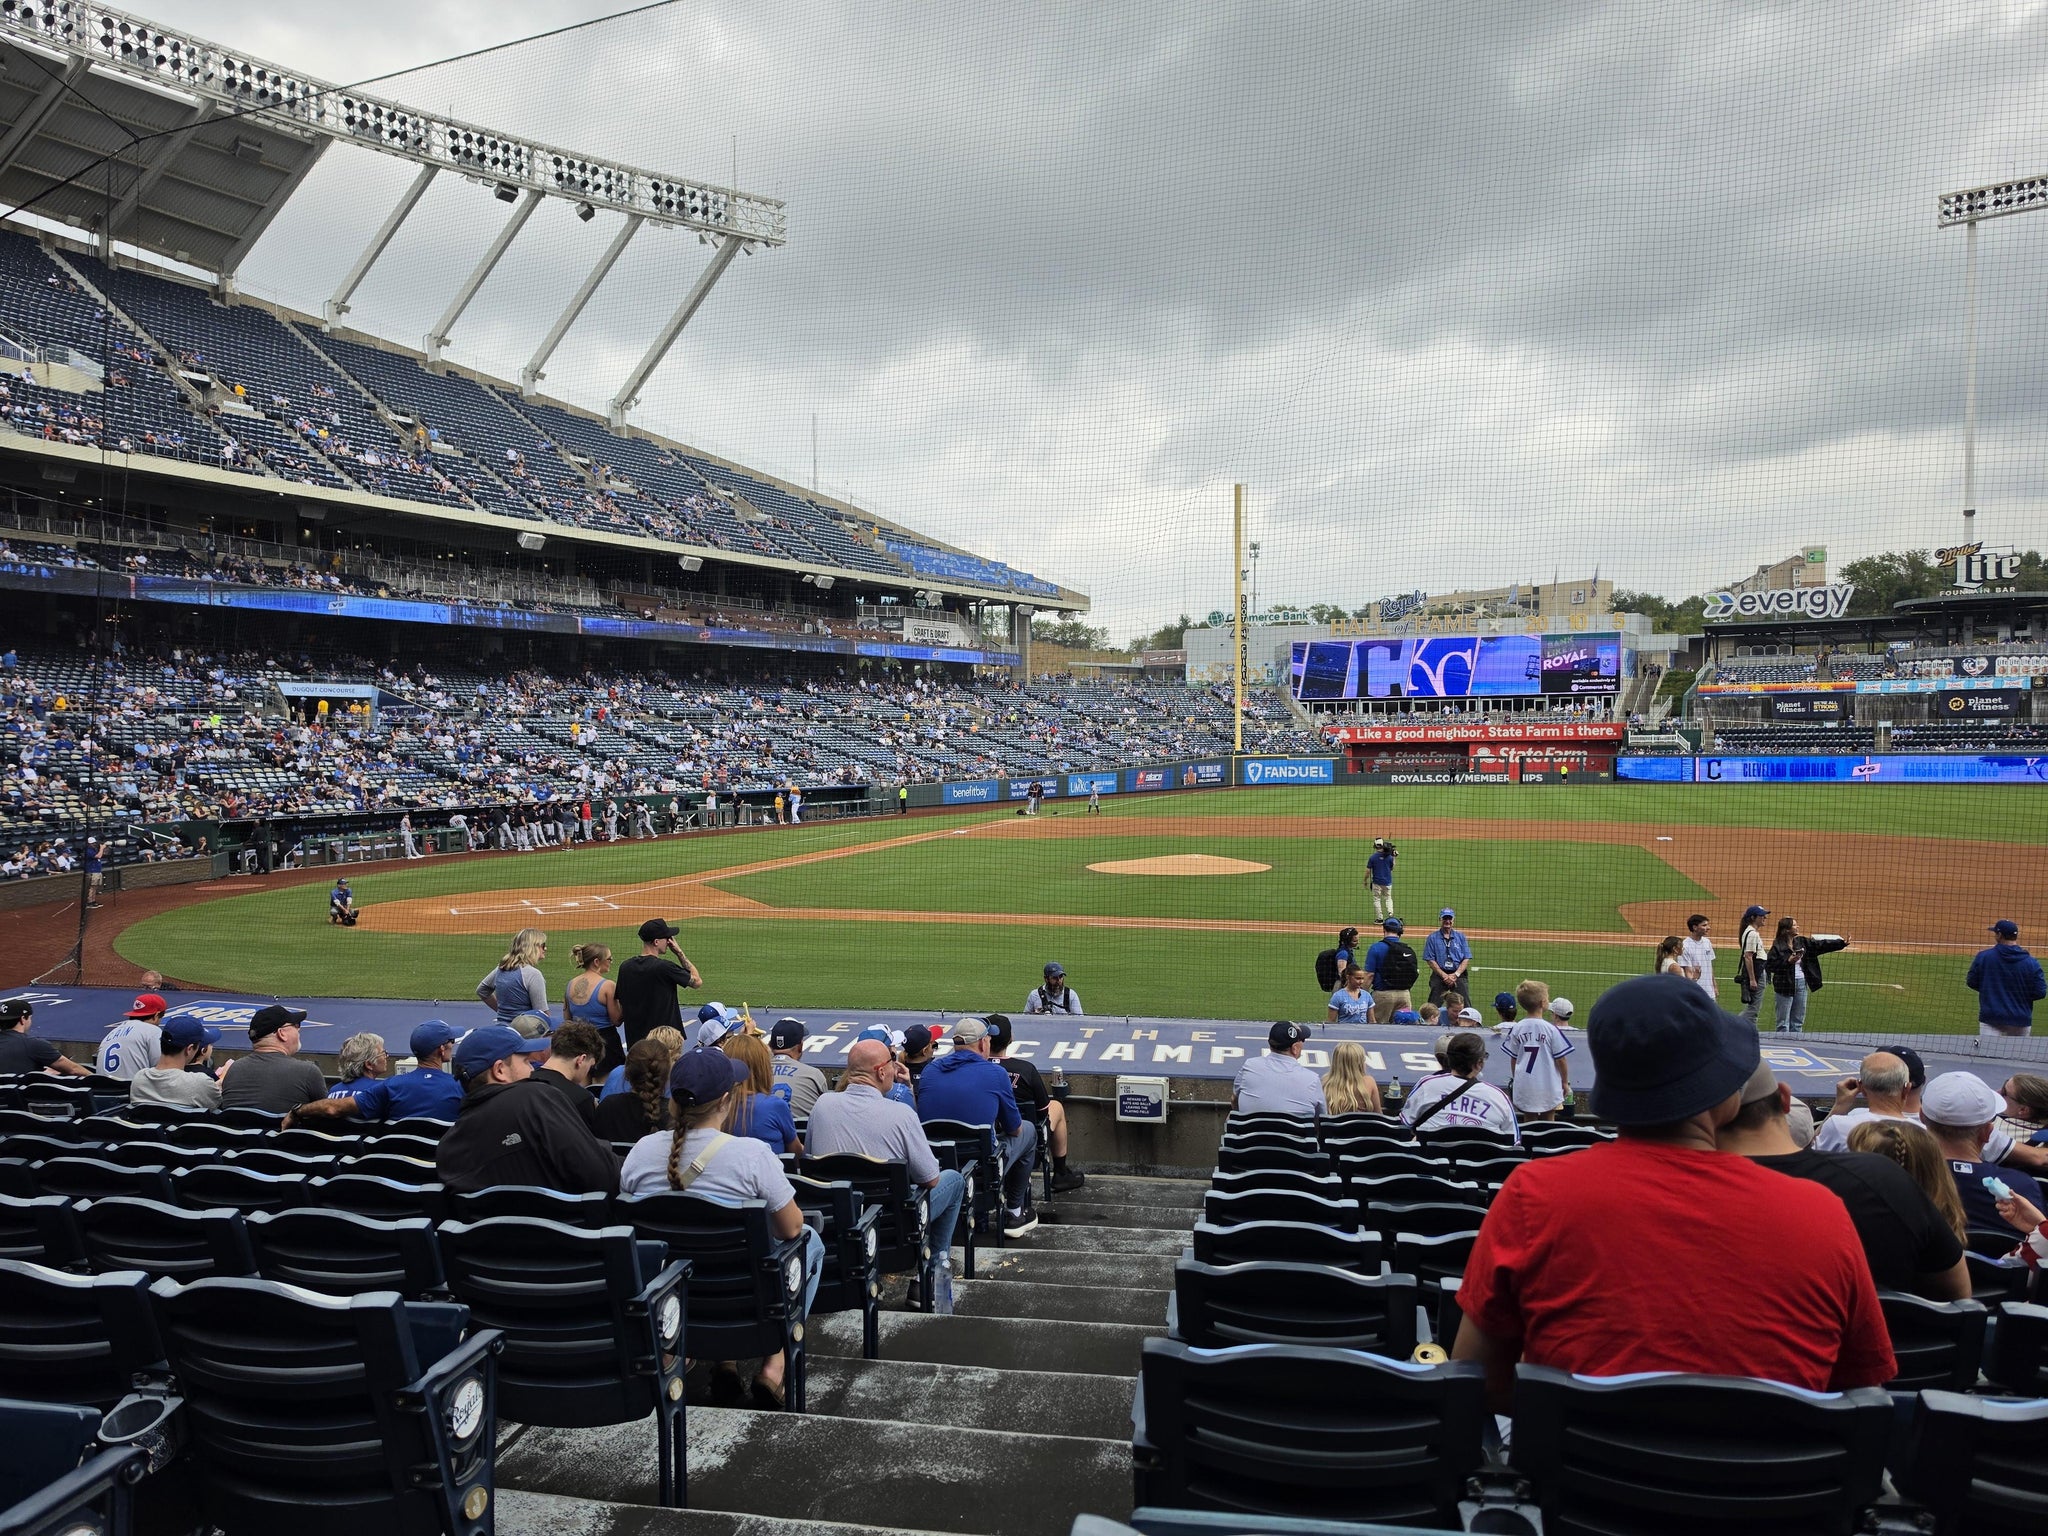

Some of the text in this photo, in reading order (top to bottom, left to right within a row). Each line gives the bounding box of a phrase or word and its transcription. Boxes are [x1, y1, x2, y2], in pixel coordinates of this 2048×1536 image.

[1935, 543, 1982, 563] Miller
[1953, 554, 2021, 588] Lite
[1939, 587, 1990, 597] FOUNTAIN
[1378, 589, 1428, 619] Royals
[1739, 588, 1850, 615] evergy
[1227, 610, 1309, 622] Cmerce Bank
[1330, 618, 1389, 636] HALL
[1414, 612, 1480, 634] FAME
[1525, 615, 1548, 632] 20
[1569, 613, 1588, 631] 10
[1612, 611, 1625, 630] 5
[914, 627, 930, 638] CRAFT
[934, 629, 950, 641] DRAFT
[1543, 648, 1588, 670] ROYAL
[1776, 701, 1801, 710] planet
[1968, 696, 2002, 706] planet
[1972, 703, 2010, 711] fitness
[1357, 725, 1618, 741] Like a good neighbor, State Farm is there.
[1264, 766, 1328, 779] FANDUEL
[1707, 759, 1722, 780] C
[1743, 762, 1787, 778] CLEVELAND
[1857, 765, 1876, 773] VS
[1941, 762, 1960, 778] CITY
[953, 785, 989, 799] benefitbay
[1070, 780, 1089, 793] UMKC
[106, 1025, 134, 1042] CAIN
[104, 1042, 121, 1074] 6
[1523, 1046, 1540, 1074] 7
